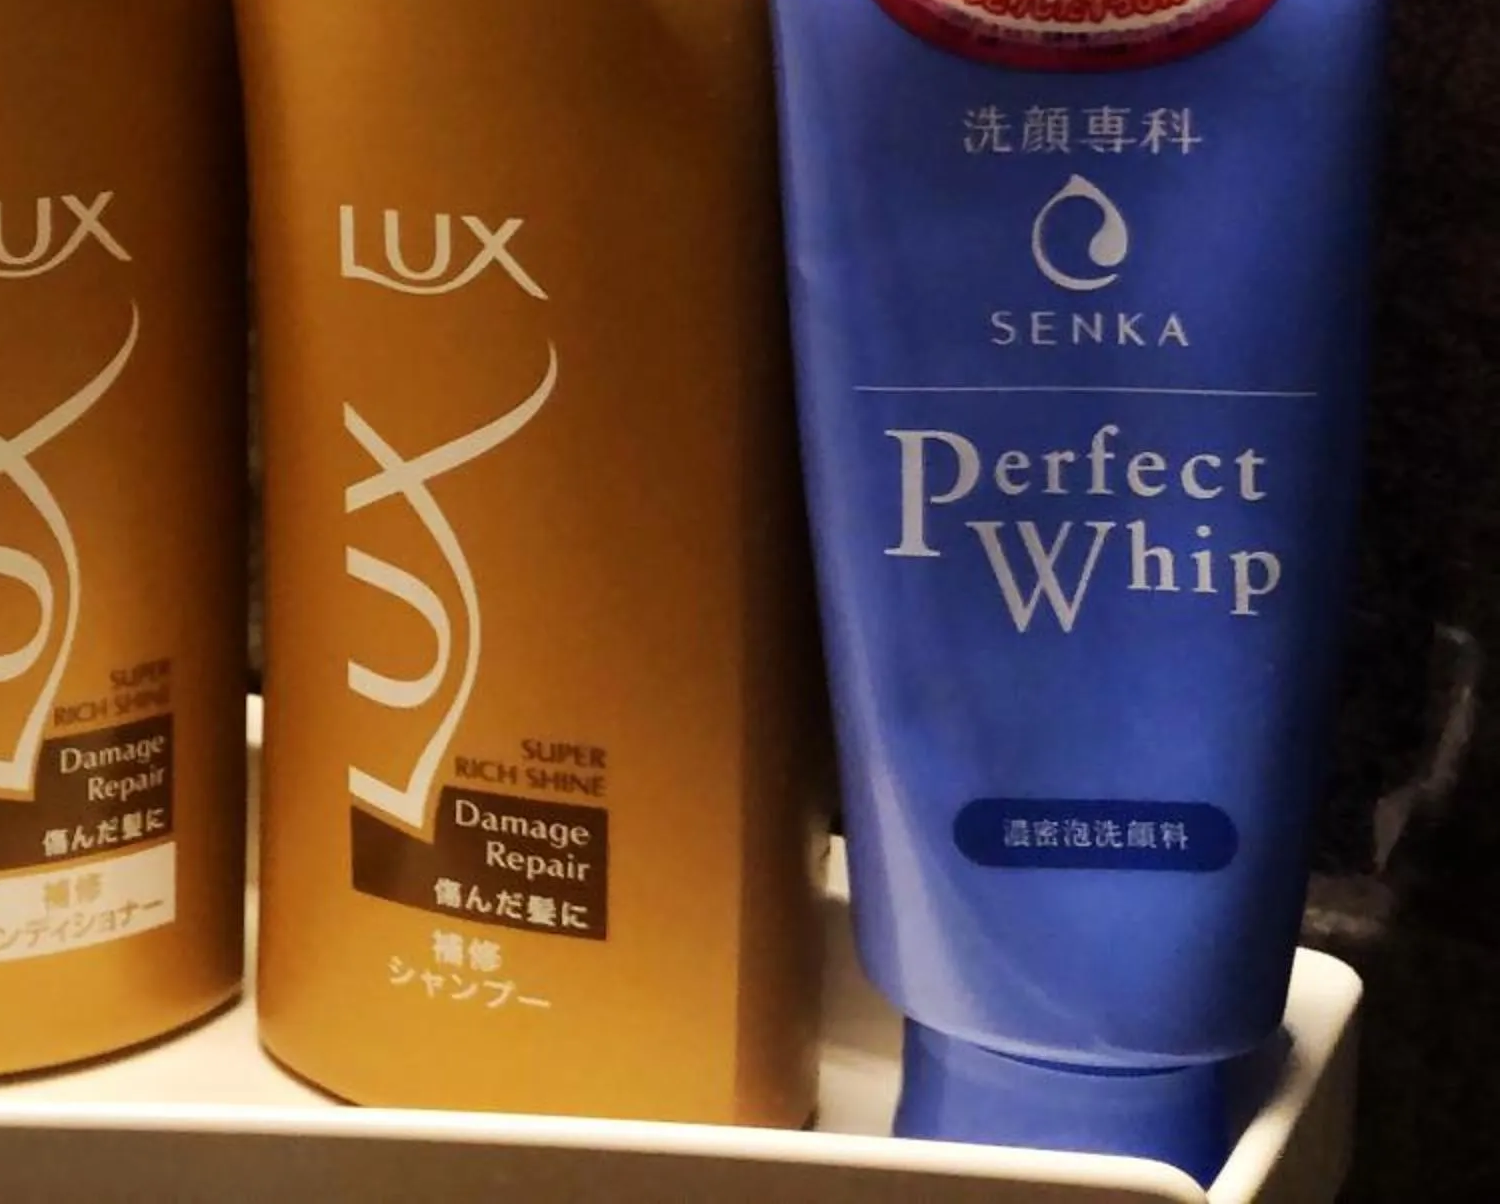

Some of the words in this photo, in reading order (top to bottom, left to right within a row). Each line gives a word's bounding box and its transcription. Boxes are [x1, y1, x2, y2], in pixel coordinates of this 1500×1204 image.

[963, 105, 1204, 154] 洗顔専科
[339, 204, 549, 300] LUX
[990, 310, 1190, 347] SENKA
[883, 424, 1267, 557] Perfect
[342, 339, 559, 830] LUX
[965, 518, 1283, 634] Whip
[53, 702, 108, 728] RICH
[59, 734, 166, 774] Damage
[454, 755, 518, 785] RICH
[525, 766, 606, 797] SHINE
[521, 739, 606, 769] SUPER
[87, 765, 167, 802] Repair
[454, 798, 592, 849] Damage
[1004, 819, 1190, 849] 濃密泡洗顔料
[485, 840, 591, 882] Repair
[433, 877, 590, 929] 傷んだ髪に
[388, 955, 551, 1009] シャンプー
